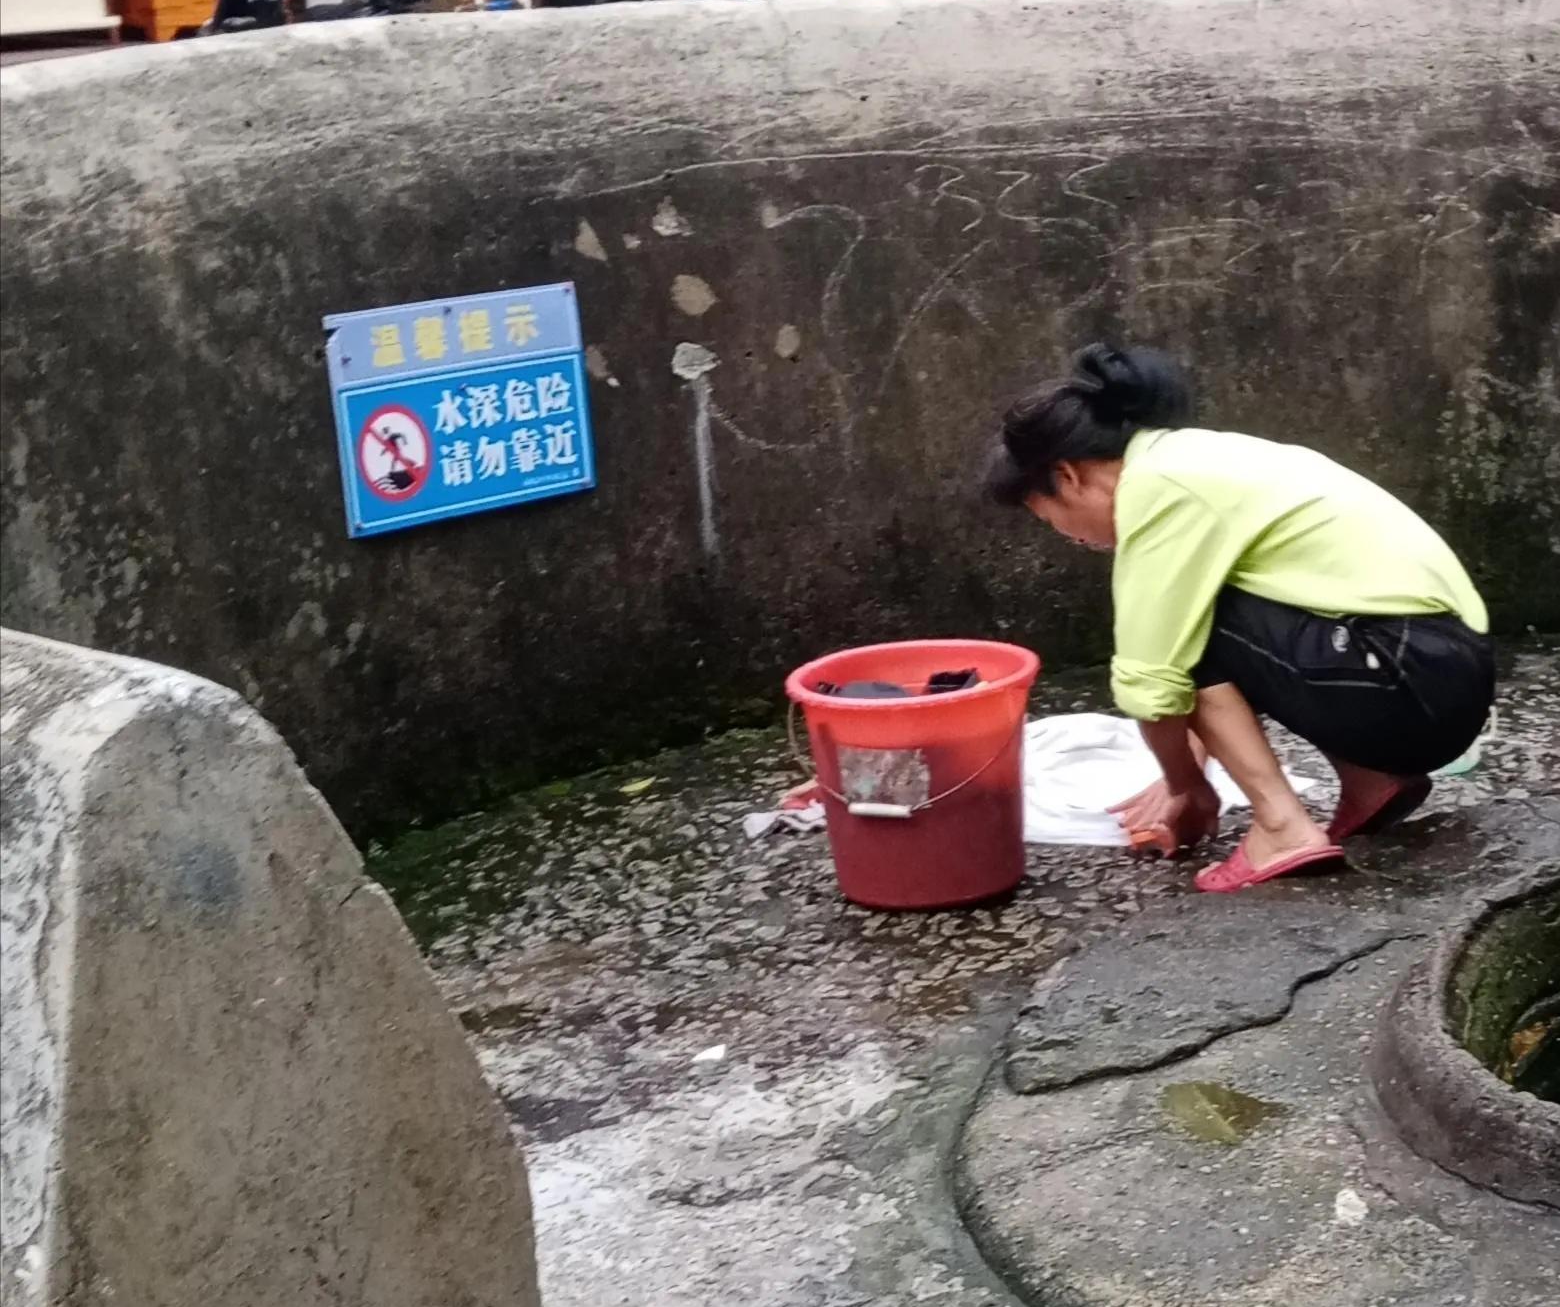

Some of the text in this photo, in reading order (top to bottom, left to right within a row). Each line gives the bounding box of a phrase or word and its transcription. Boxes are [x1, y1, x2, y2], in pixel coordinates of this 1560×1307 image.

[433, 373, 574, 435] 水深危险
[439, 420, 579, 487] 请勿靠近
